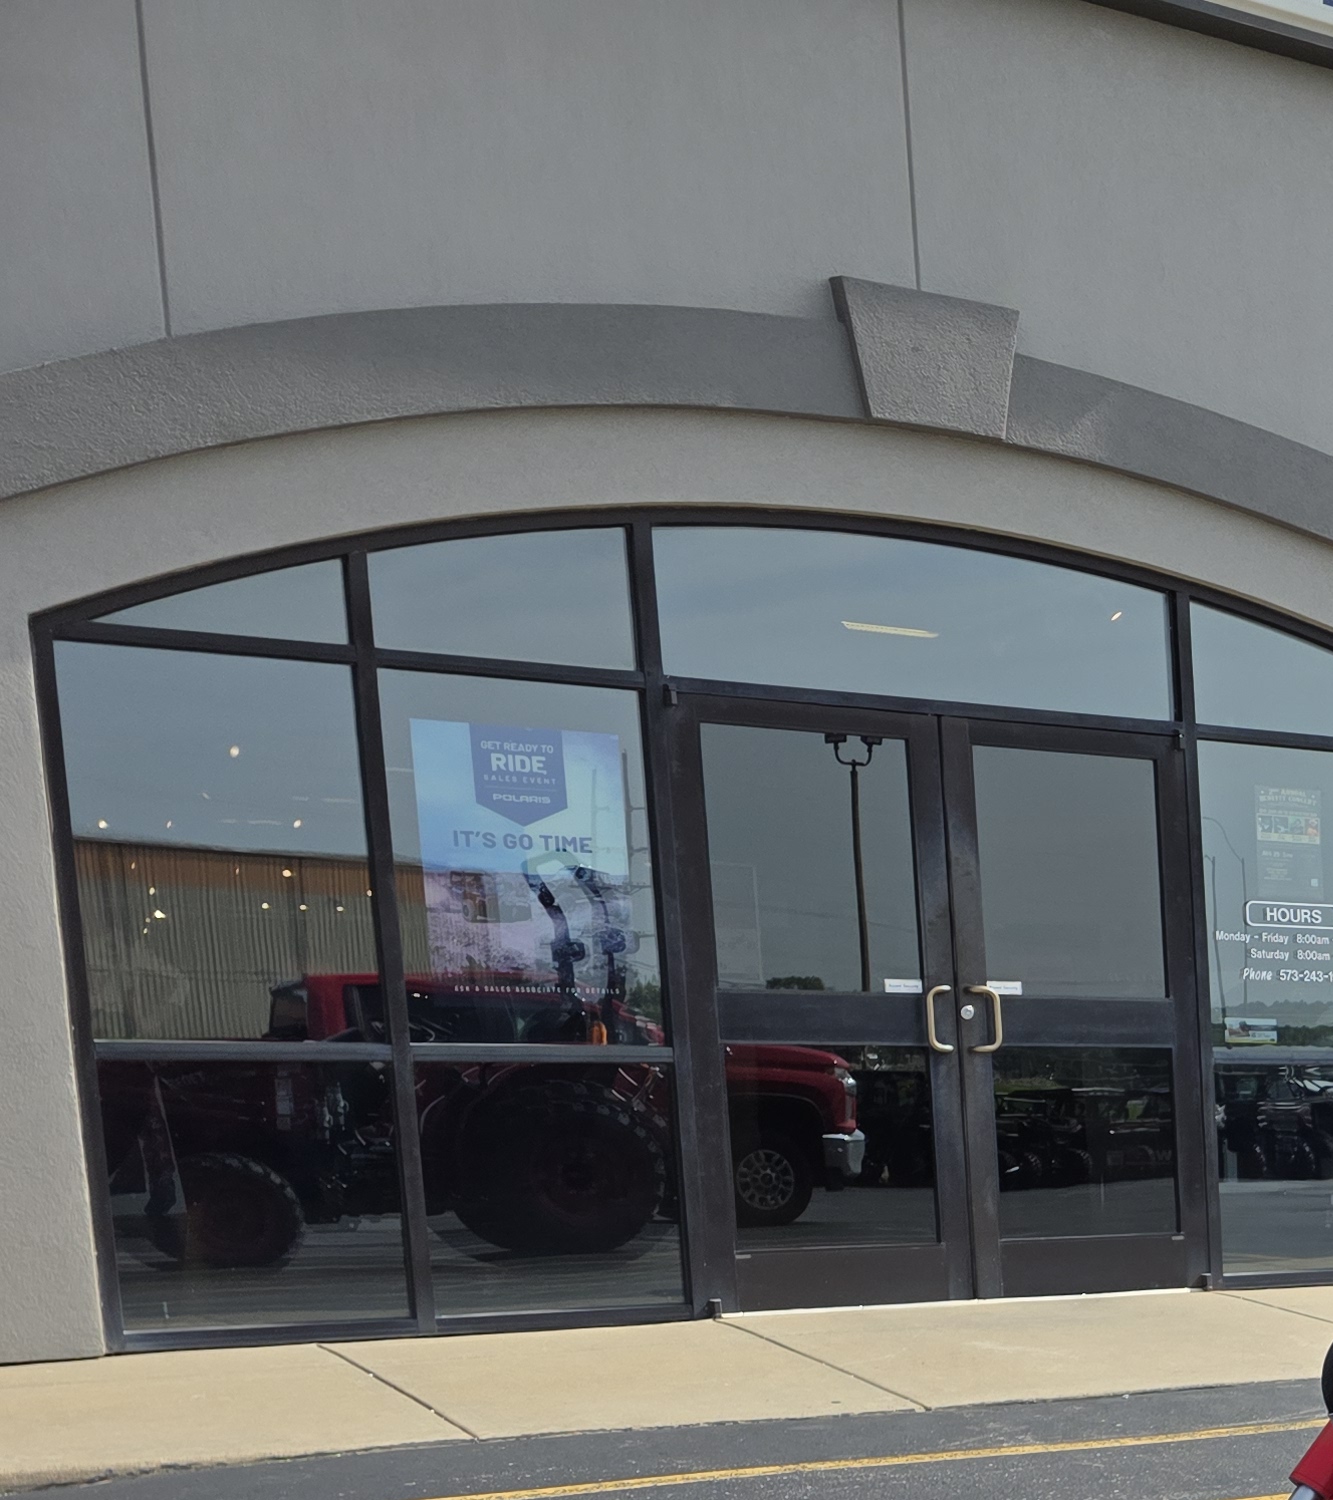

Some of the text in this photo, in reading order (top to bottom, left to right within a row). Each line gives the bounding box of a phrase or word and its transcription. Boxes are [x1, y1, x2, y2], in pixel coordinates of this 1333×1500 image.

[480, 740, 554, 754] GET READY TO
[490, 753, 547, 775] RIDE
[483, 774, 556, 785] SALES EVENT
[492, 793, 551, 804] POLARIS
[453, 830, 593, 853] IT'S GO TIME
[1266, 907, 1322, 923] HOURS
[1215, 930, 1250, 943] Monday
[1262, 932, 1289, 945] Friday
[1296, 934, 1329, 945] 8:00am
[1250, 949, 1289, 961] Saturday
[1297, 950, 1331, 961] 8:00am
[1243, 968, 1273, 981] Phone
[484, 985, 511, 993] SALES
[515, 985, 561, 993] ASSOCIATE
